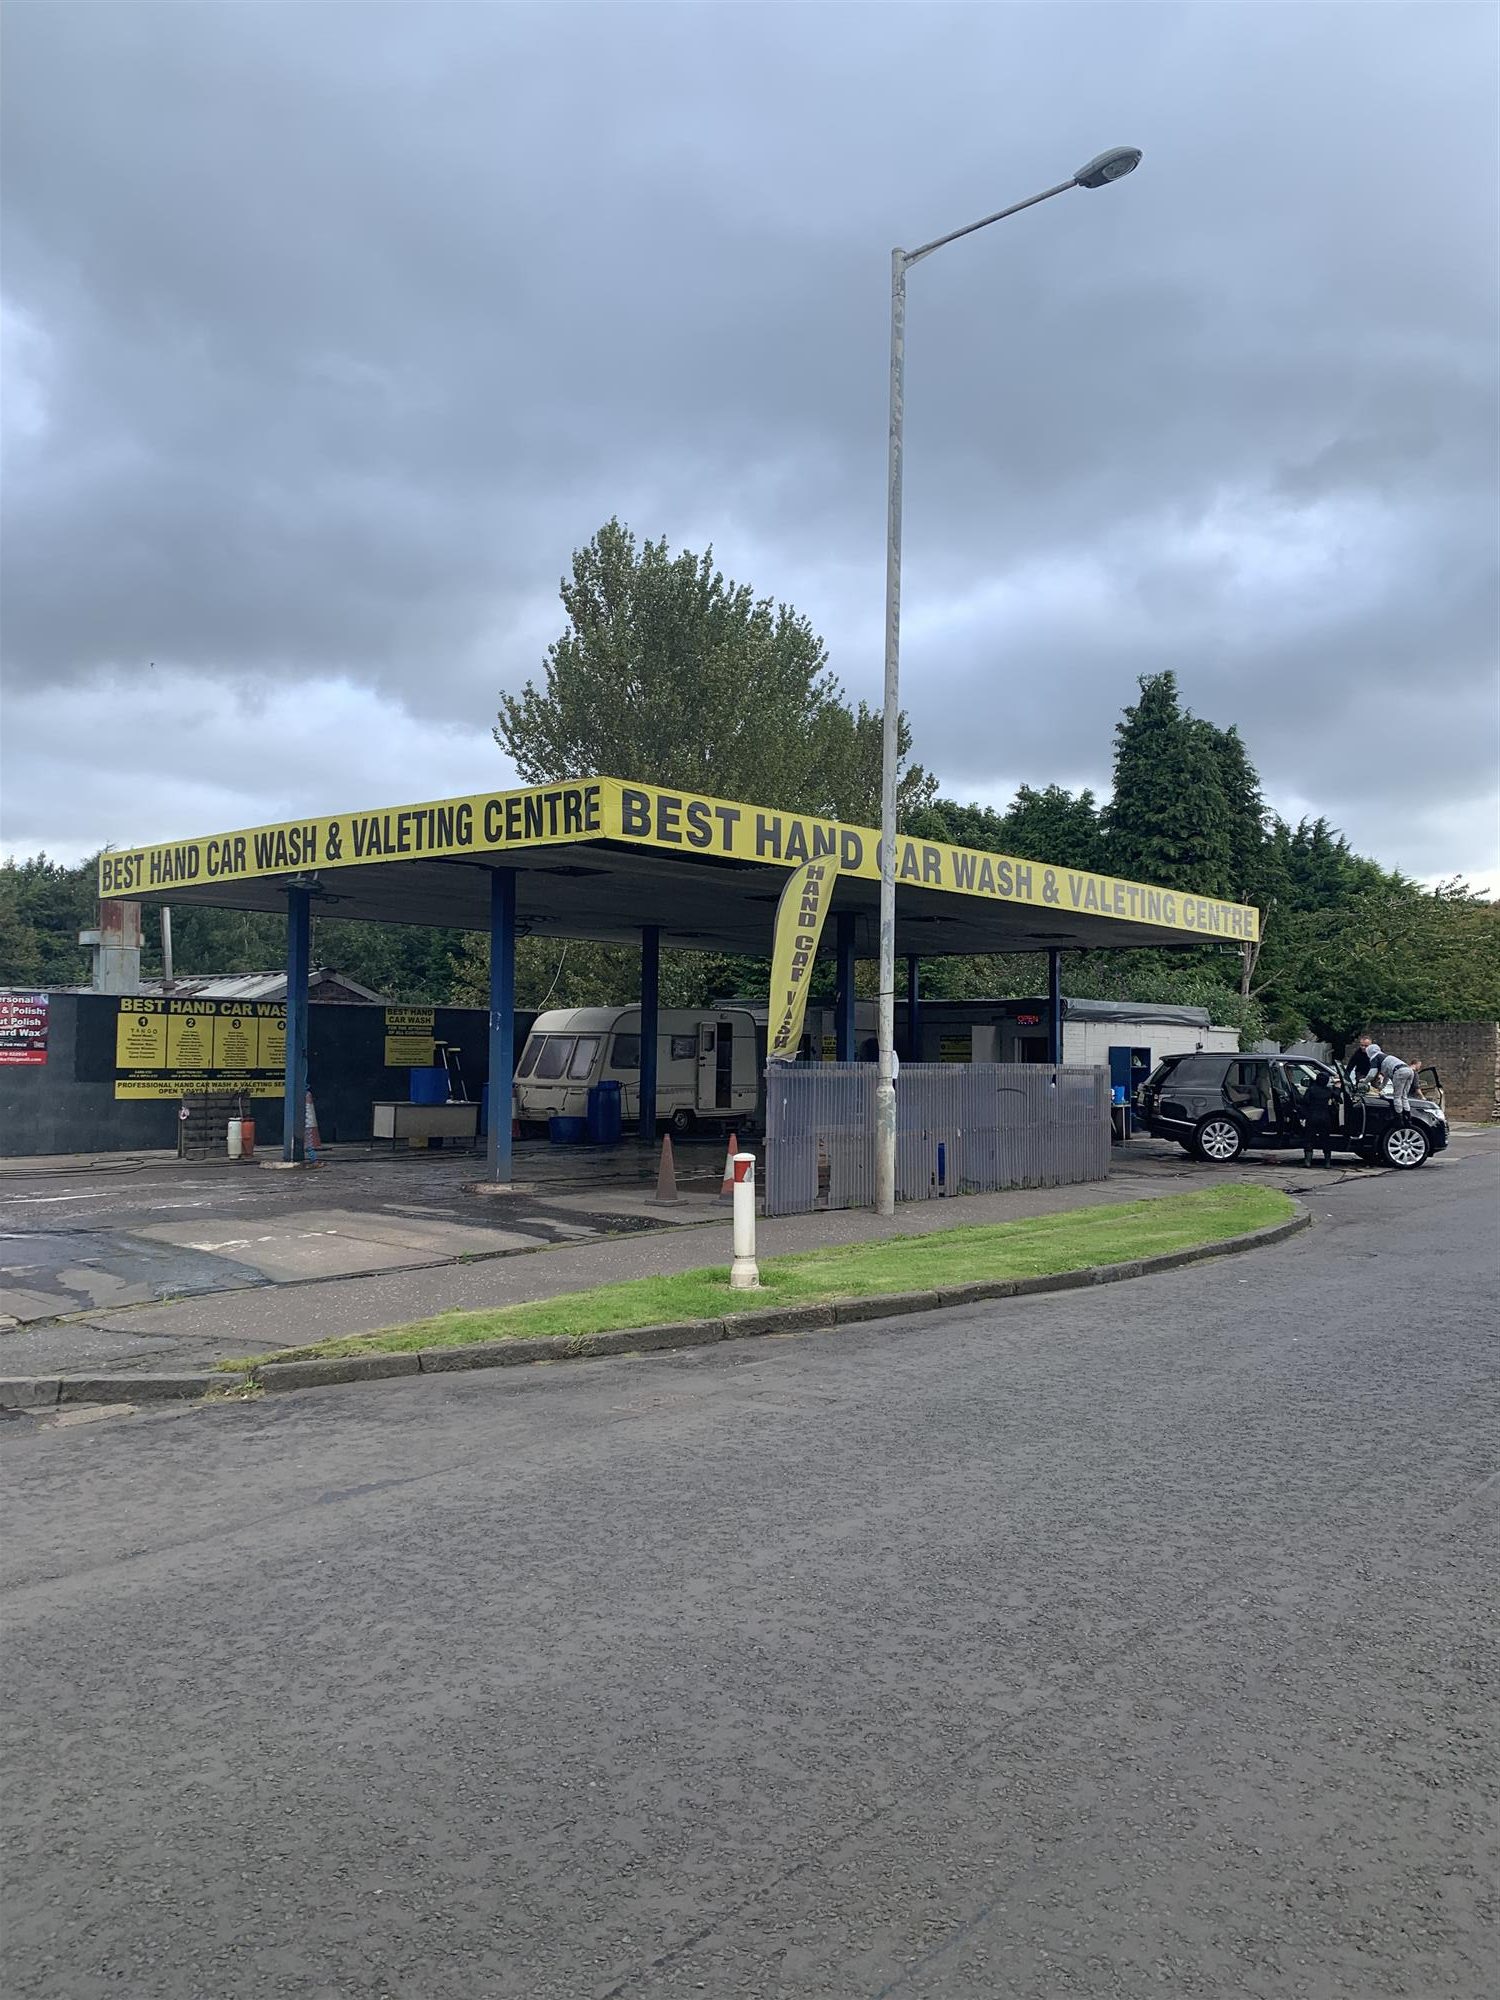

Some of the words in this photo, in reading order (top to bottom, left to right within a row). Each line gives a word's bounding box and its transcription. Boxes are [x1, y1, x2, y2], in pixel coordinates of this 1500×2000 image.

[103, 854, 144, 891] BEST
[150, 845, 199, 884] HAND
[207, 837, 246, 876] CAR
[254, 825, 317, 869] WASH
[325, 821, 342, 861] &
[352, 803, 473, 857] VALETING
[484, 786, 600, 843] CENTRE
[622, 788, 741, 851] BEST
[755, 813, 863, 870] HAND
[952, 852, 1032, 899] WASH
[1042, 869, 1060, 904] &
[1068, 874, 1176, 924] VALETING
[1183, 898, 1254, 937] CENTRE
[797, 864, 826, 928] HAND
[12, 1006, 46, 1016] Polish;
[120, 998, 165, 1012] BEST
[170, 1000, 216, 1014] HAND
[220, 1002, 253, 1016] CAR
[11, 1018, 41, 1026] Polish
[389, 1016, 406, 1024] CAR
[19, 1029, 41, 1037] Wax
